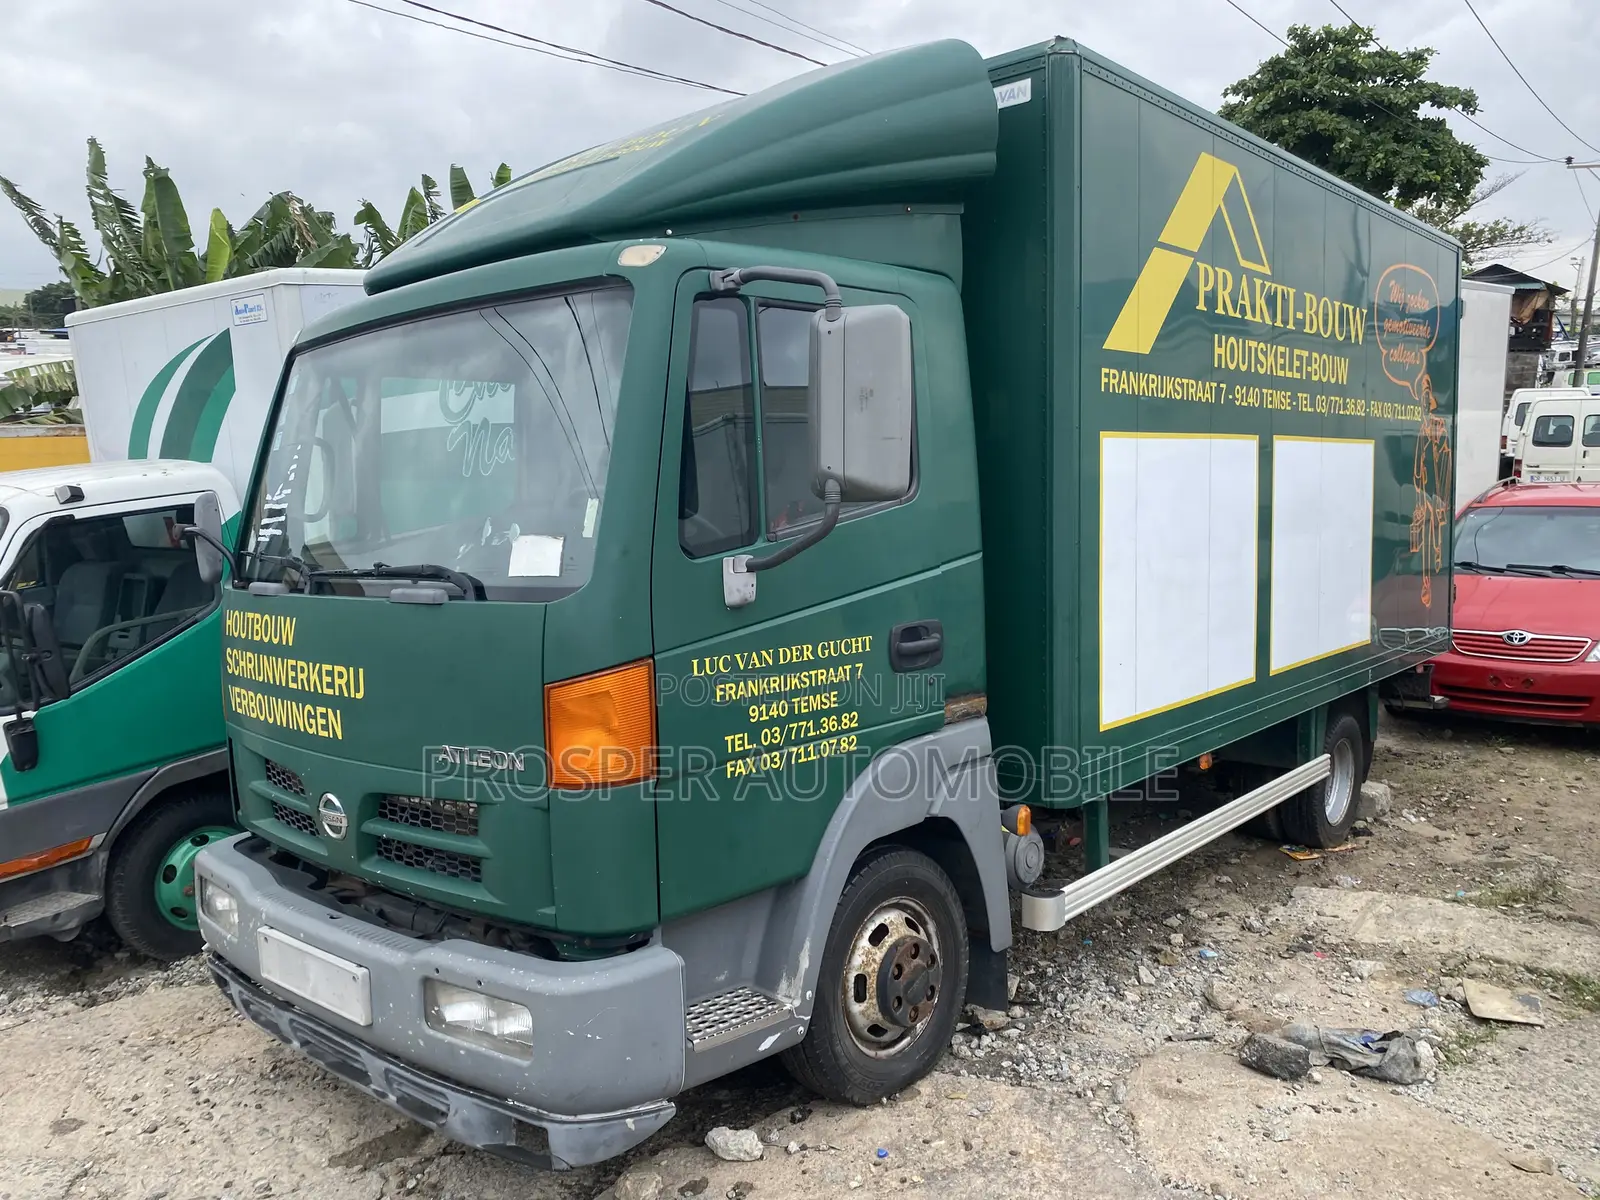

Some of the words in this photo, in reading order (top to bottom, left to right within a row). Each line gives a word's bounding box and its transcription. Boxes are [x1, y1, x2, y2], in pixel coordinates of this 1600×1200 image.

[1195, 261, 1368, 345] PRAKTI-BOUW
[1213, 334, 1349, 385] HOUTSKELET-BOUW
[1100, 367, 1217, 404] FRANKRIJKSTRAAT
[1219, 383, 1227, 405] 7
[1234, 385, 1260, 408] 9140
[1262, 388, 1292, 411] TEMSE
[1298, 393, 1315, 413] TEL.
[1315, 396, 1366, 417] 03/771.36.82
[1370, 401, 1383, 418] FAX
[1383, 402, 1422, 422] 03/711.07.82
[225, 609, 297, 647] HOUTBOUW
[225, 647, 365, 700] SCHRIJNWERKERIJ
[691, 654, 731, 677] LUC
[734, 649, 774, 670] VAN
[777, 643, 814, 664] DER
[817, 635, 873, 658] GUCHT
[714, 666, 851, 702] FRANKRIJKSTRAAT
[854, 663, 864, 680] 7
[228, 684, 343, 740] VERBOUWINGEN
[748, 706, 789, 724] 9140
[791, 690, 839, 716] TEMSE
[724, 732, 757, 754] TEL.
[760, 711, 859, 747] 03/771.36.82
[437, 745, 524, 771] ATLEON
[725, 756, 757, 779] FAX
[759, 735, 858, 772] 03/711.07.82
